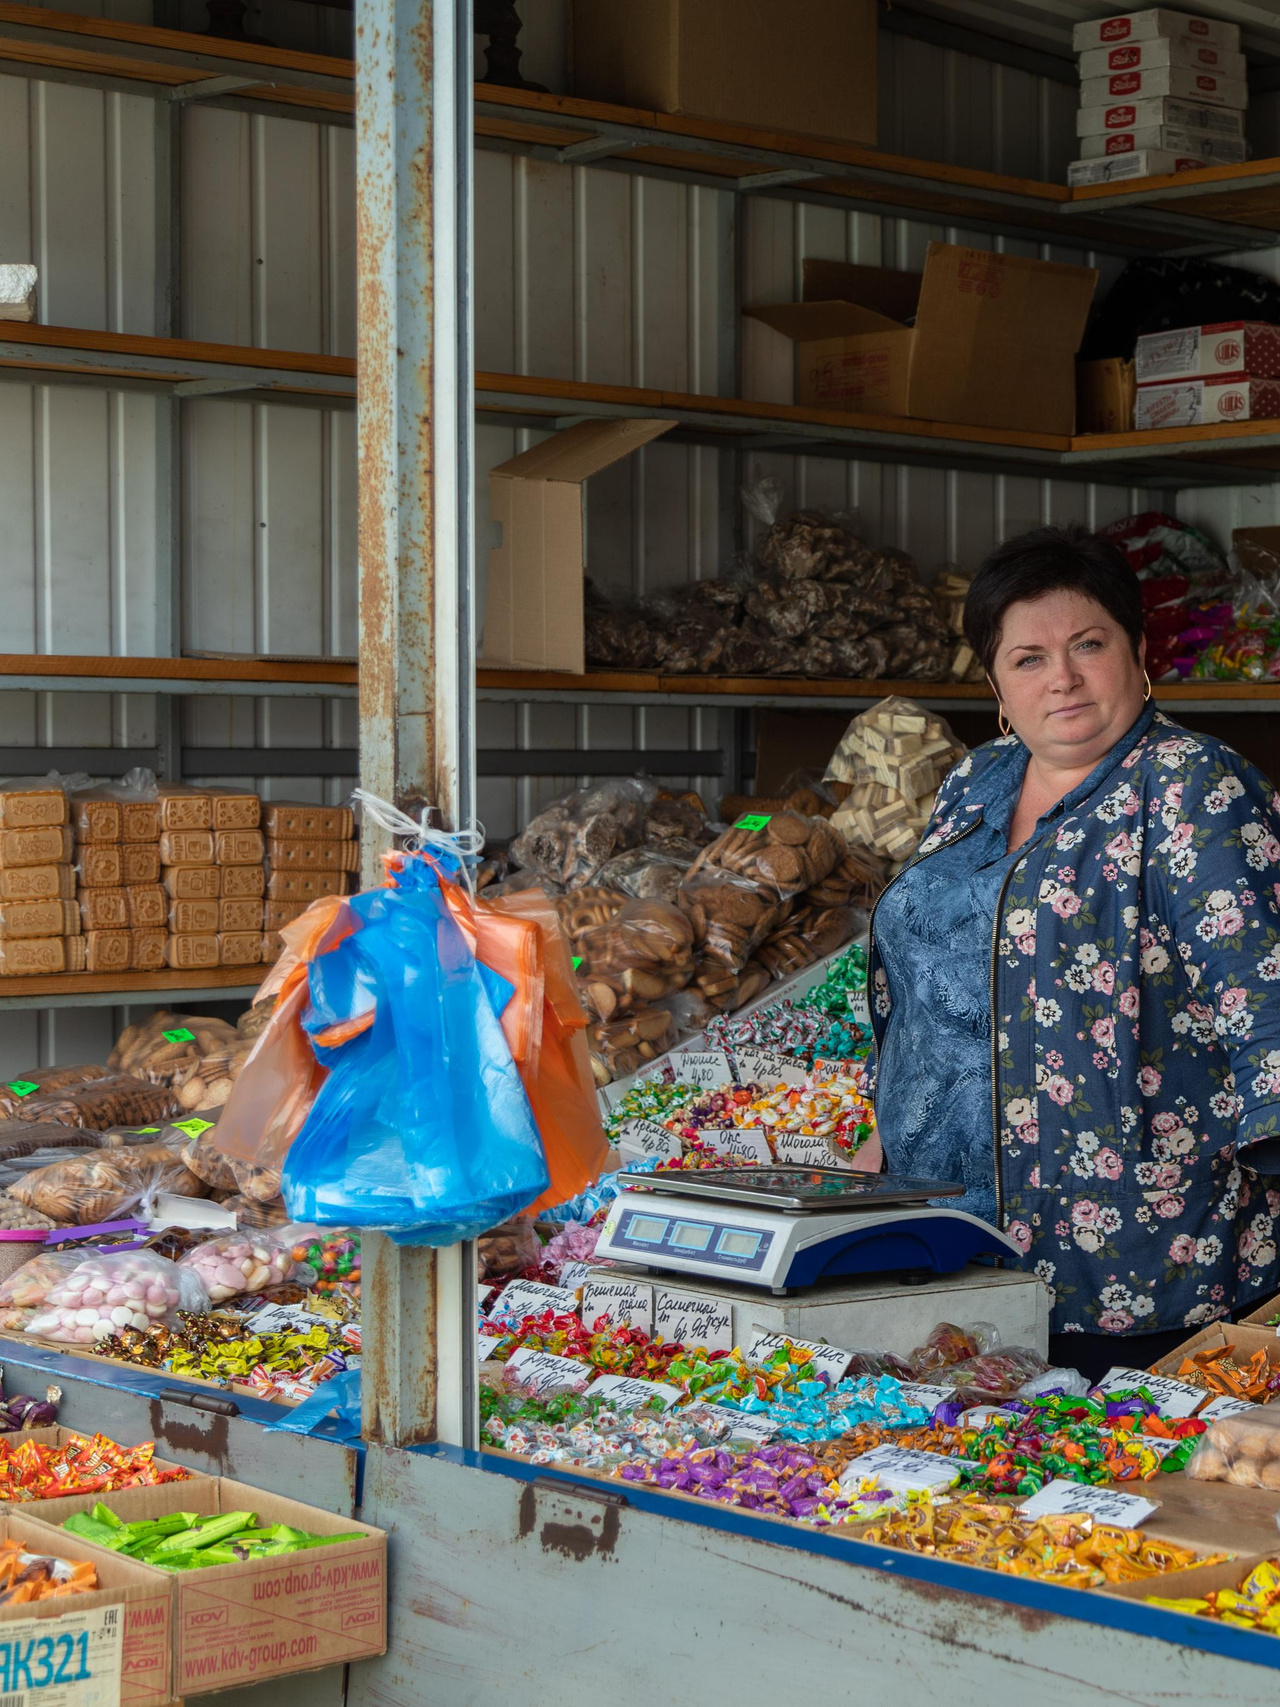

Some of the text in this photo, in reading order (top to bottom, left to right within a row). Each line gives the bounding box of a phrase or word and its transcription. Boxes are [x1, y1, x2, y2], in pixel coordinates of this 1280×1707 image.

[254, 1559, 380, 1600] www.kdv-group.com
[190, 1609, 225, 1626] KDV
[345, 1609, 376, 1626] KDV
[124, 1657, 159, 1671] KDV
[185, 1634, 318, 1679] www.kdv-group.com
